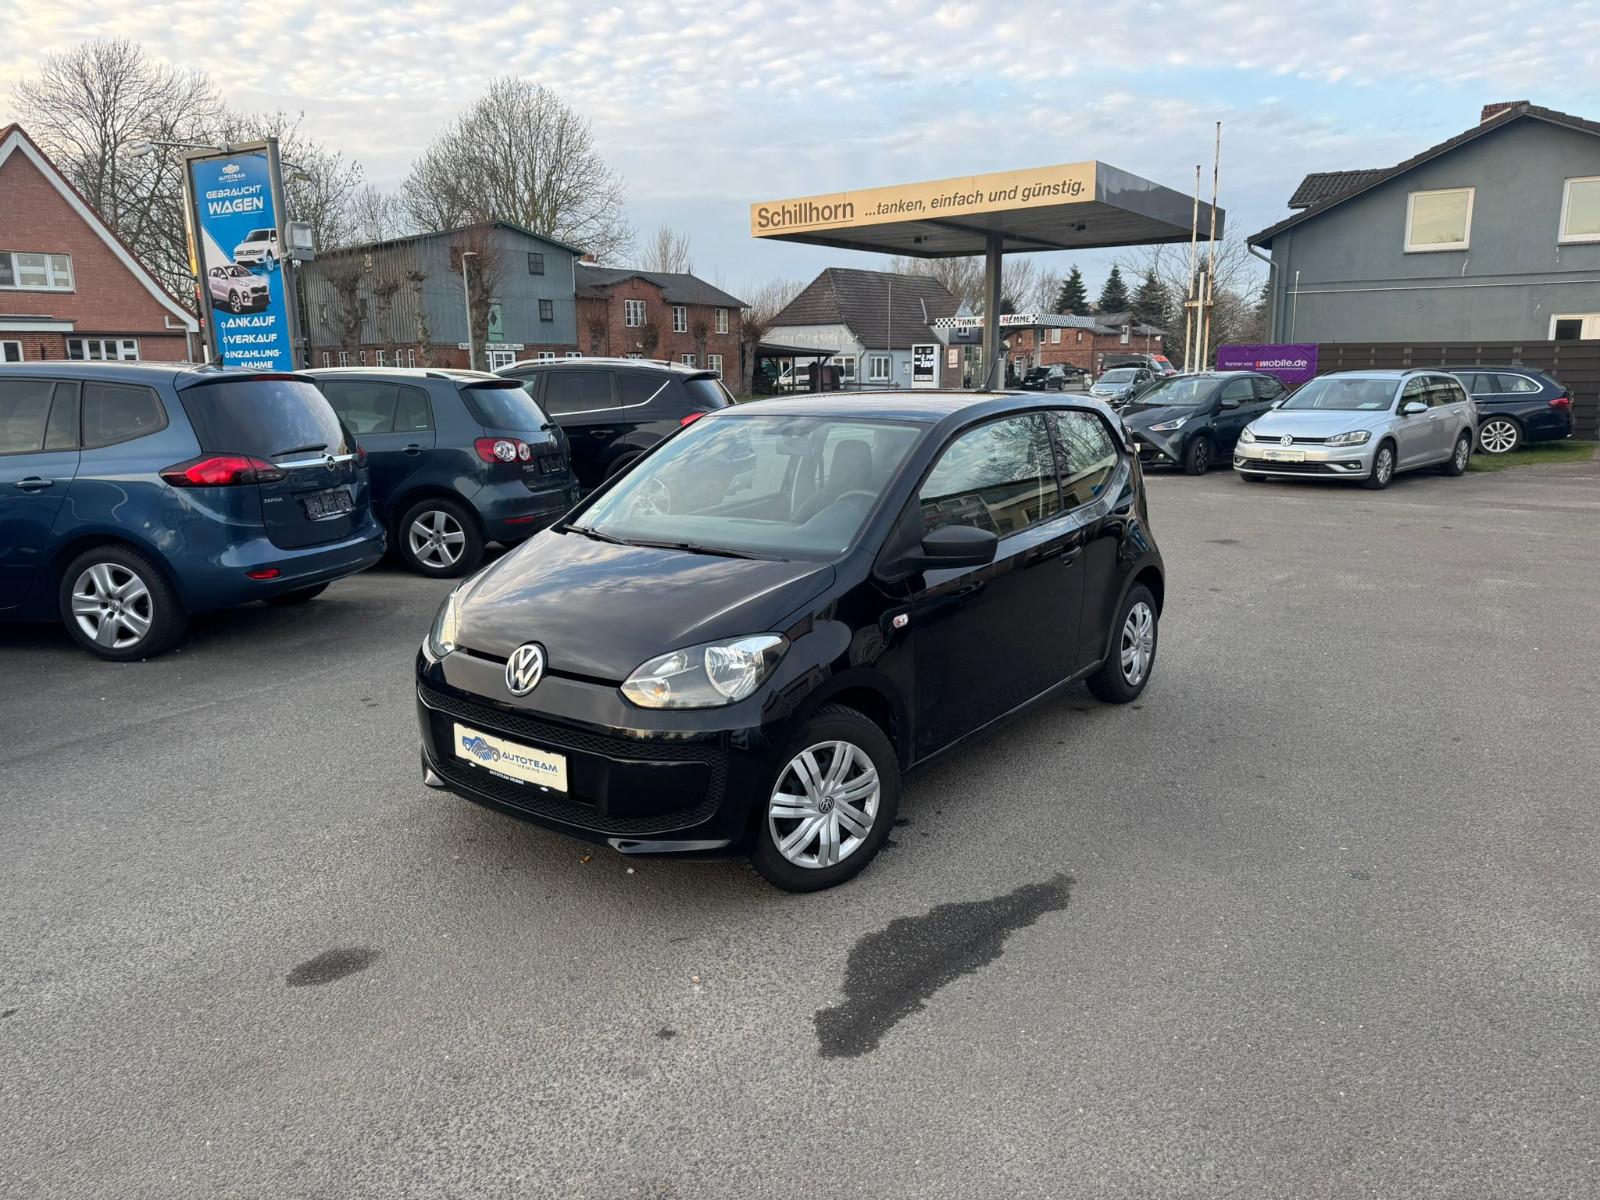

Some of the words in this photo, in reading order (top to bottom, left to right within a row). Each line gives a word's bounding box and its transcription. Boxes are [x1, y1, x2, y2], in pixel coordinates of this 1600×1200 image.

[206, 184, 261, 199] GEBRAUCHT
[208, 196, 263, 215] WAGEN
[757, 201, 854, 228] Schillhorn
[865, 199, 926, 217] ...tanken,
[931, 190, 983, 209] einfach
[988, 186, 1018, 202] und
[1021, 178, 1085, 201] günstig.
[226, 316, 276, 328] ANKAUF
[228, 333, 278, 344] VERKAUF
[230, 349, 282, 359] INZAHLUNG-
[241, 360, 273, 369] NAHME
[1256, 359, 1308, 368] mobile.de
[502, 751, 558, 773] AUTOTEAM
